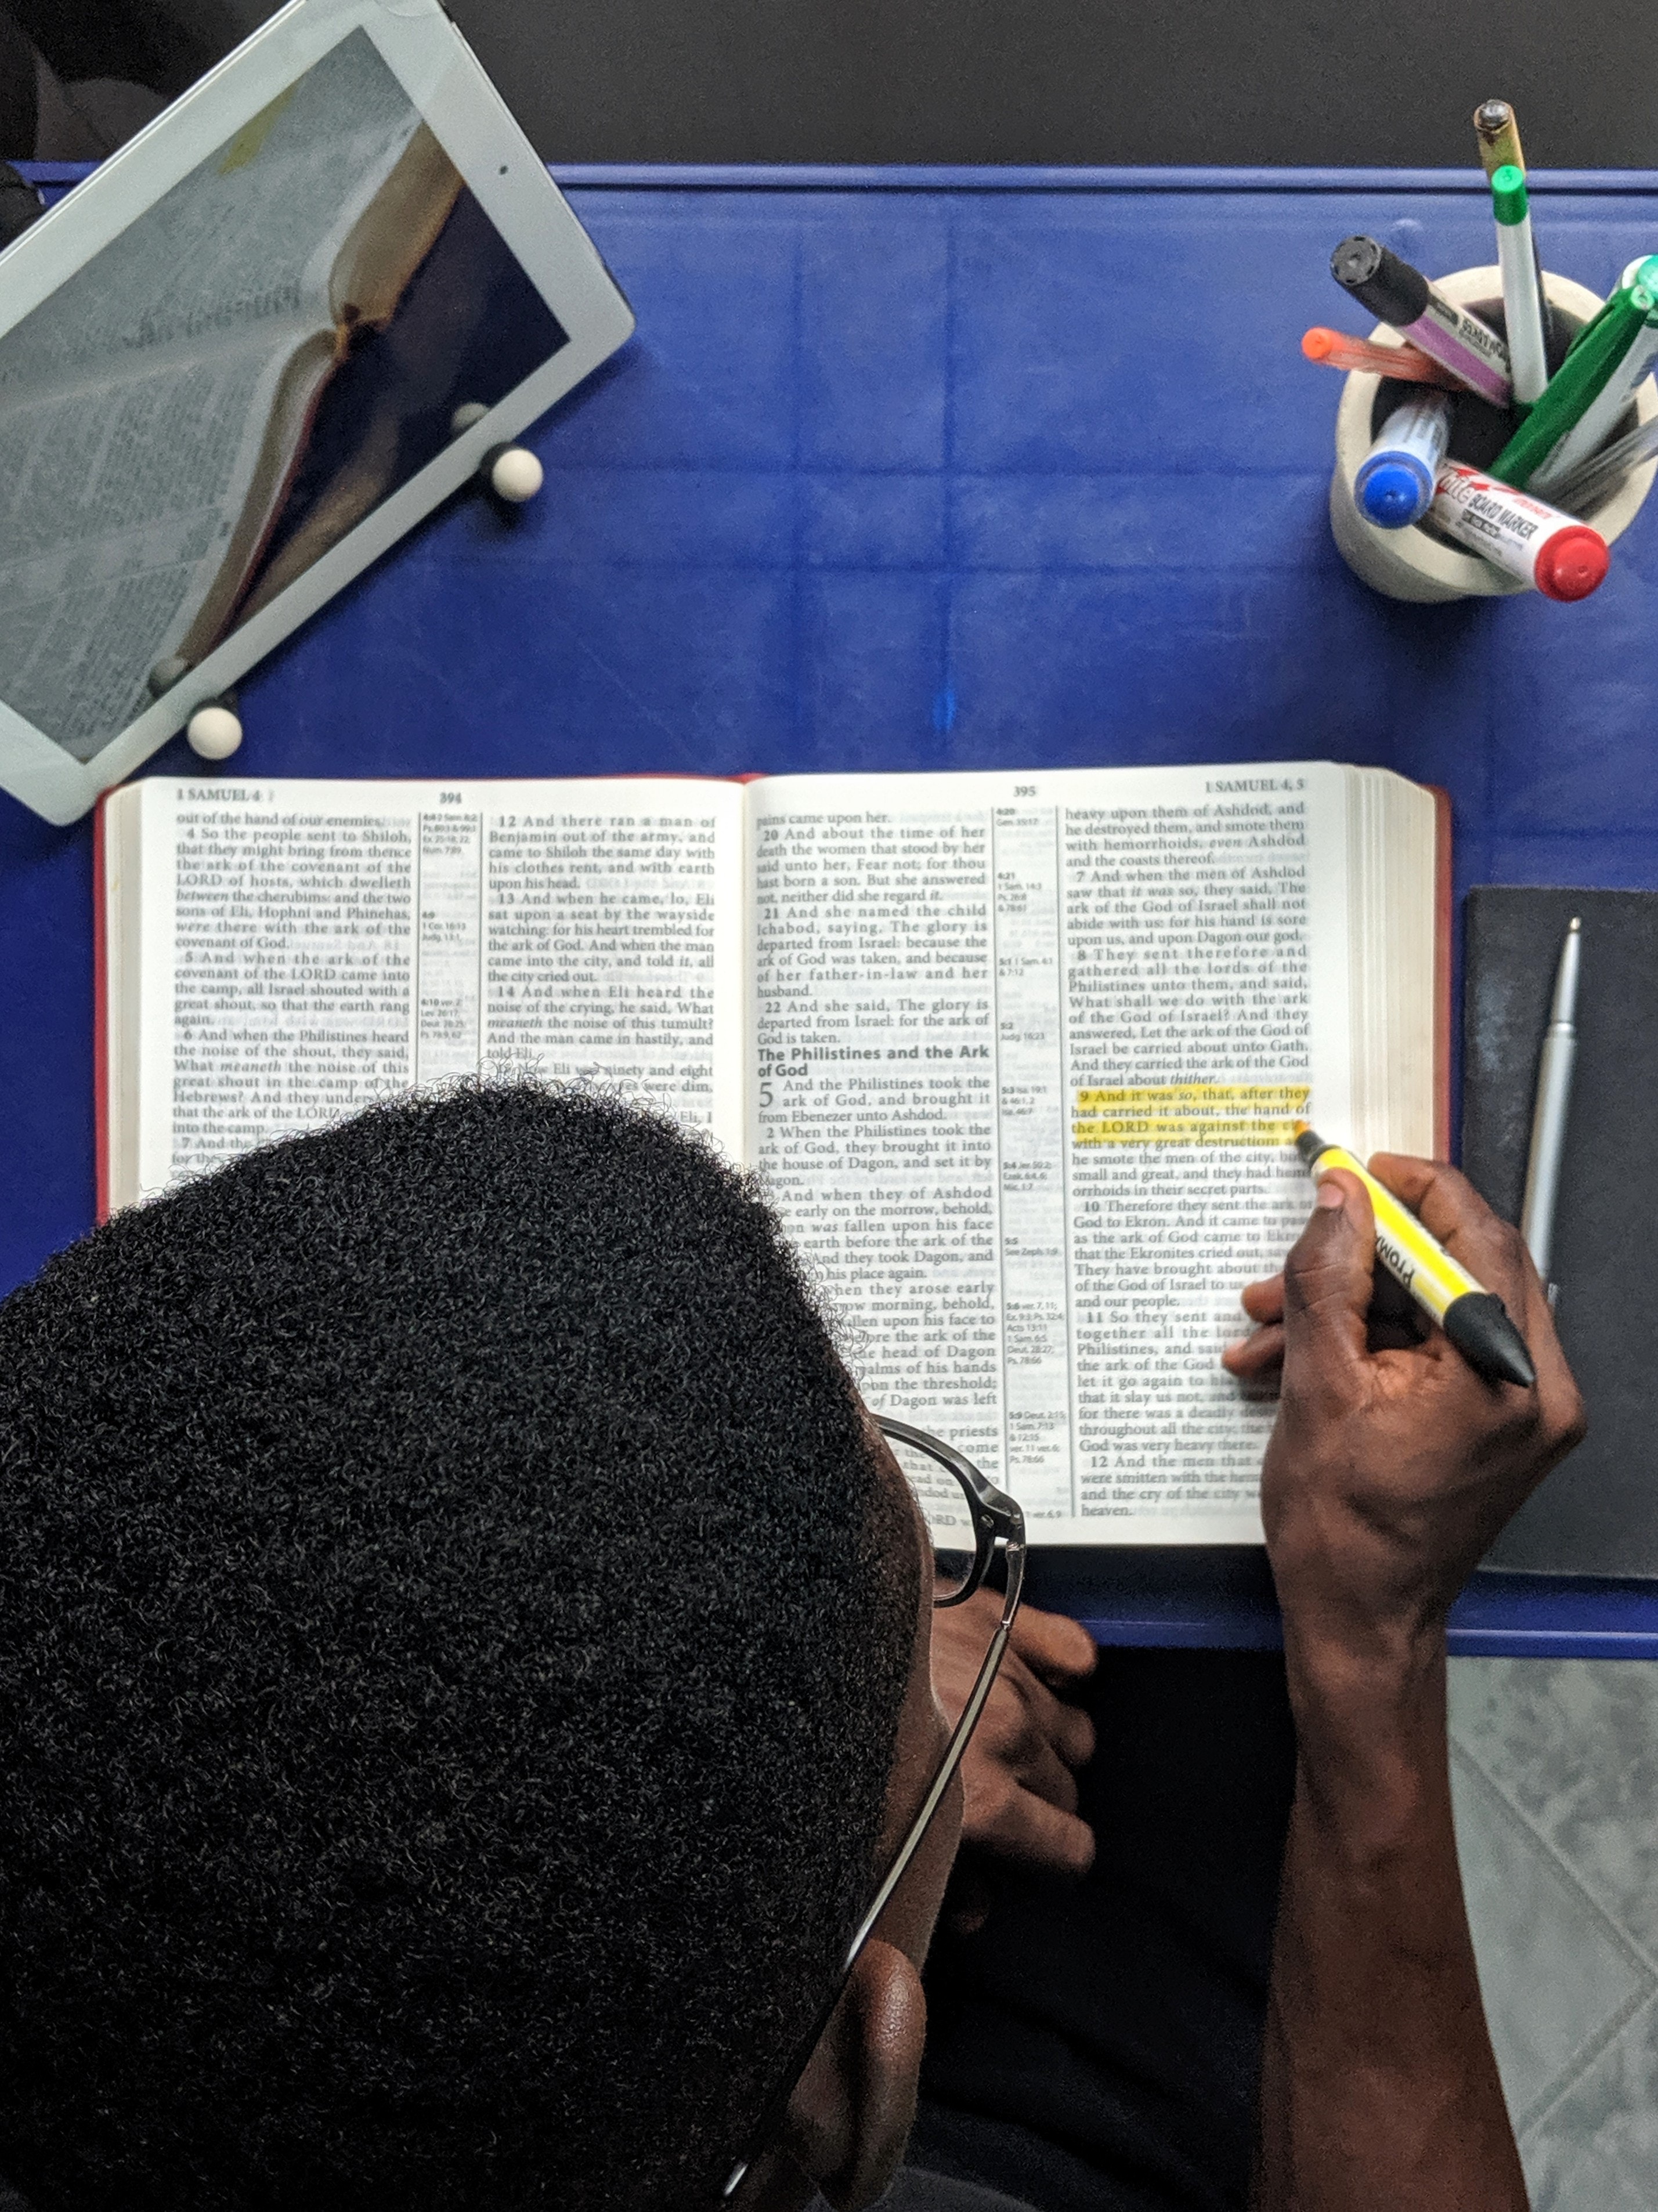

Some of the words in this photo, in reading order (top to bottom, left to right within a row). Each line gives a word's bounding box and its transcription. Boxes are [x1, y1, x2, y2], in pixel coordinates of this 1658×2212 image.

[1469, 493, 1504, 519] BOARD
[1496, 508, 1540, 541] MARKER
[1014, 782, 1036, 796] 395
[1205, 779, 1212, 791] 1
[1215, 778, 1278, 791] SAMUEL
[1296, 777, 1305, 789] 5
[176, 787, 183, 799] 1
[187, 787, 249, 800] SAMUEL
[252, 788, 261, 801] 4
[439, 790, 462, 803] 394
[176, 811, 200, 823] out
[201, 811, 219, 823] of
[219, 811, 241, 824] the
[244, 812, 279, 825] hand
[281, 813, 299, 825] of
[298, 816, 324, 826] our
[186, 826, 196, 838] 4
[201, 827, 219, 839] So
[223, 827, 247, 840] the
[252, 827, 302, 844] people
[306, 829, 336, 841] sent
[342, 829, 357, 842] to
[763, 827, 780, 840] 20
[785, 827, 816, 840] And
[822, 826, 864, 839] about
[870, 826, 894, 838] the
[900, 826, 933, 838] time
[939, 825, 956, 838] of
[960, 825, 986, 837] her
[175, 873, 223, 885] LORD
[228, 874, 244, 886] of
[299, 875, 344, 888] which
[349, 876, 411, 888] dwelleth
[1076, 870, 1086, 882] 7
[1092, 869, 1122, 882] And
[1125, 868, 1164, 881] when
[1168, 868, 1191, 880] the
[1195, 870, 1227, 879] men
[1230, 866, 1247, 879] of
[1250, 865, 1307, 878] Ashdod
[497, 891, 515, 903] 13
[521, 891, 552, 904] And
[555, 892, 594, 904] when
[598, 892, 617, 904] he
[696, 892, 714, 905] Eli
[175, 908, 206, 917] sons
[211, 905, 227, 917] of
[257, 905, 311, 921] Hophni
[315, 906, 341, 918] and
[487, 957, 522, 966] came
[526, 954, 554, 966] into
[556, 954, 580, 966] the
[616, 955, 642, 967] and
[646, 955, 674, 967] told
[698, 955, 714, 967] all
[496, 984, 516, 996] 14
[522, 984, 554, 997] And
[561, 985, 601, 997] when
[606, 985, 631, 997] Eli
[635, 985, 683, 998] heard
[690, 986, 714, 998] the
[1068, 978, 1146, 992] Philistines
[1151, 978, 1186, 991] unto
[1239, 977, 1270, 989] and
[764, 1000, 782, 1012] 22
[788, 999, 819, 1012] And
[824, 999, 849, 1011] she
[895, 998, 926, 1010] The
[931, 997, 970, 1013] glory
[976, 997, 988, 1010] is
[756, 1015, 812, 1031] departed
[816, 1015, 850, 1028] from
[898, 1014, 918, 1027] for
[923, 1014, 944, 1027] the
[948, 1014, 971, 1026] ark
[974, 1013, 991, 1026] of
[756, 1032, 783, 1044] God
[786, 1031, 797, 1044] is
[757, 1047, 785, 1061] The
[790, 1046, 881, 1060] Philistines
[887, 1045, 920, 1059] and
[925, 1044, 953, 1058] the
[959, 1044, 989, 1058] Ark
[758, 1063, 772, 1076] of
[775, 1062, 808, 1076] God
[758, 1082, 774, 1108] 5
[783, 1078, 814, 1091] And
[819, 1078, 842, 1090] the
[847, 1076, 923, 1090] Philistines
[928, 1076, 964, 1089] took
[966, 1075, 990, 1088] the
[782, 1094, 807, 1107] ark
[813, 1094, 830, 1106] of
[878, 1092, 907, 1105] and
[911, 1091, 973, 1107] brought
[979, 1091, 990, 1103] it
[1081, 1089, 1090, 1102] 9
[1095, 1089, 1126, 1101] And
[1130, 1089, 1144, 1101] it
[1147, 1091, 1177, 1101] was
[1240, 1087, 1273, 1099] after
[1279, 1086, 1310, 1101] they
[757, 1110, 788, 1123] from
[791, 1109, 853, 1122] Ebenezer
[856, 1108, 888, 1121] unto
[1070, 1105, 1099, 1118] had
[1103, 1104, 1154, 1118] carried
[1158, 1104, 1170, 1116] it
[1224, 1103, 1251, 1115] the
[1253, 1102, 1292, 1115] hand
[1295, 1101, 1312, 1114] of
[1071, 1121, 1095, 1133] the
[1101, 1120, 1150, 1133] LORD
[1156, 1123, 1184, 1132] was
[1190, 1119, 1247, 1134] against
[1251, 1118, 1277, 1131] the
[1077, 1375, 1097, 1387] let
[1101, 1375, 1113, 1387] it
[1117, 1378, 1138, 1390] go
[1141, 1374, 1183, 1389] again
[1188, 1374, 1205, 1386] to
